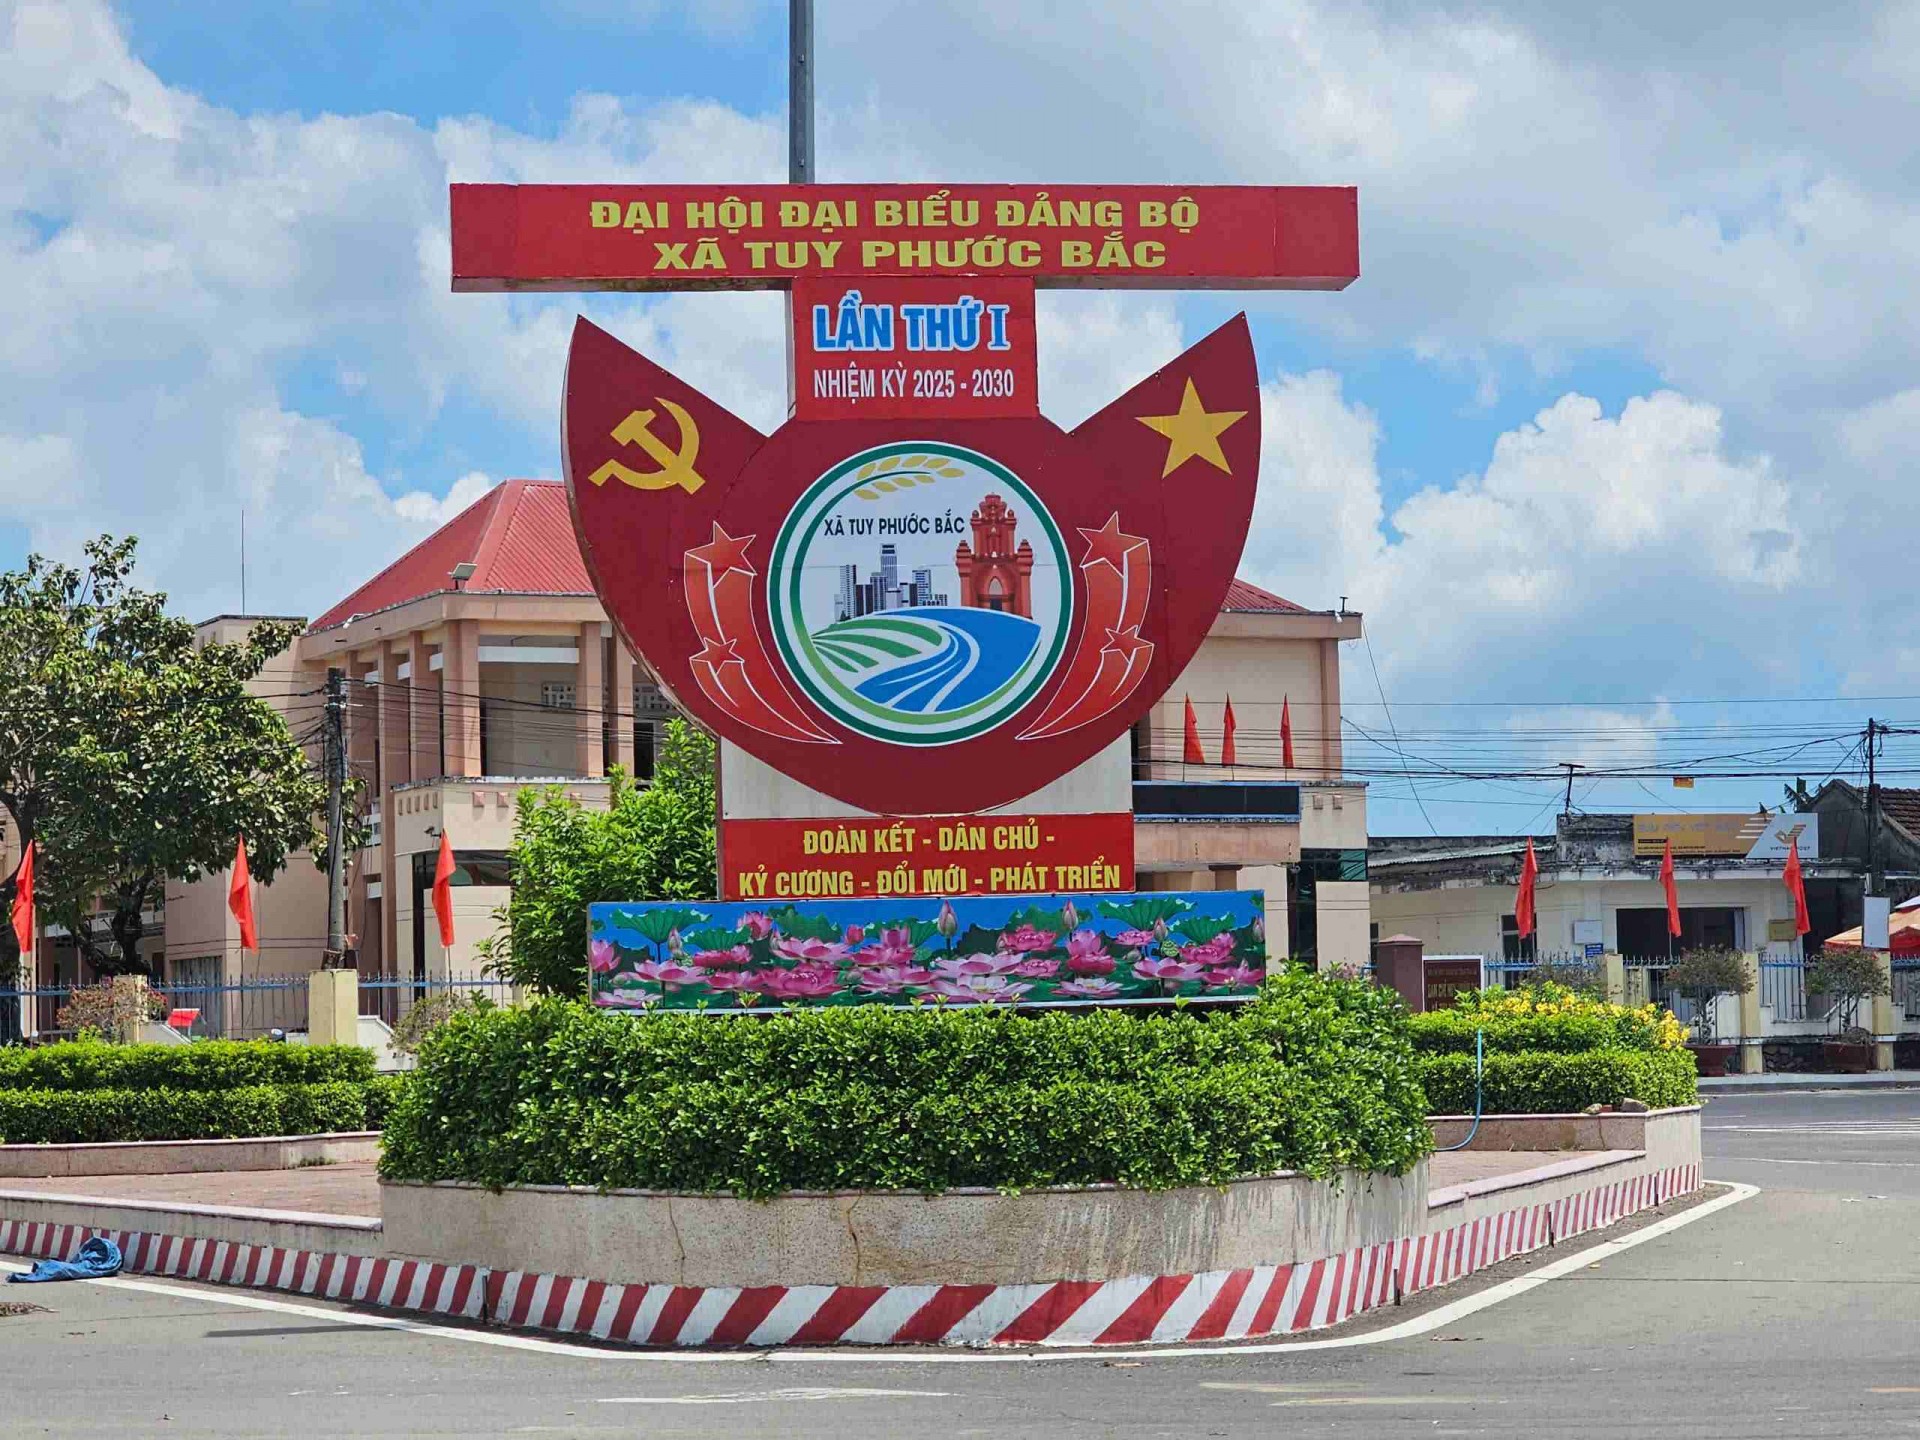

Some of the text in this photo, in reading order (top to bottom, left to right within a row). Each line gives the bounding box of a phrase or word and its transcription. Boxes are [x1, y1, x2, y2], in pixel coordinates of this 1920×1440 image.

[590, 190, 1199, 234] ĐẠI HỘI ĐẠI BIỂU ĐẢNG BỘ
[653, 231, 1166, 269] XÃ TUY PHƯỚC BẮC
[813, 290, 1011, 351] LẦN THỨ I
[814, 361, 1014, 404] NHIỆM KỲ 2025 - 2030
[824, 508, 965, 536] XÃ TUY PHƯỚC BẮC
[803, 825, 867, 854] ĐOÀN
[874, 820, 915, 852] KẾT
[939, 823, 986, 851] DÂN
[993, 818, 1039, 849] CHỦ
[739, 864, 768, 896] KỶ
[775, 871, 854, 896] CƯƠNG
[877, 860, 914, 894] ĐỔI
[923, 864, 967, 892] MỚI
[991, 862, 1048, 890] PHÁT
[1055, 856, 1120, 889] TRIỂN
